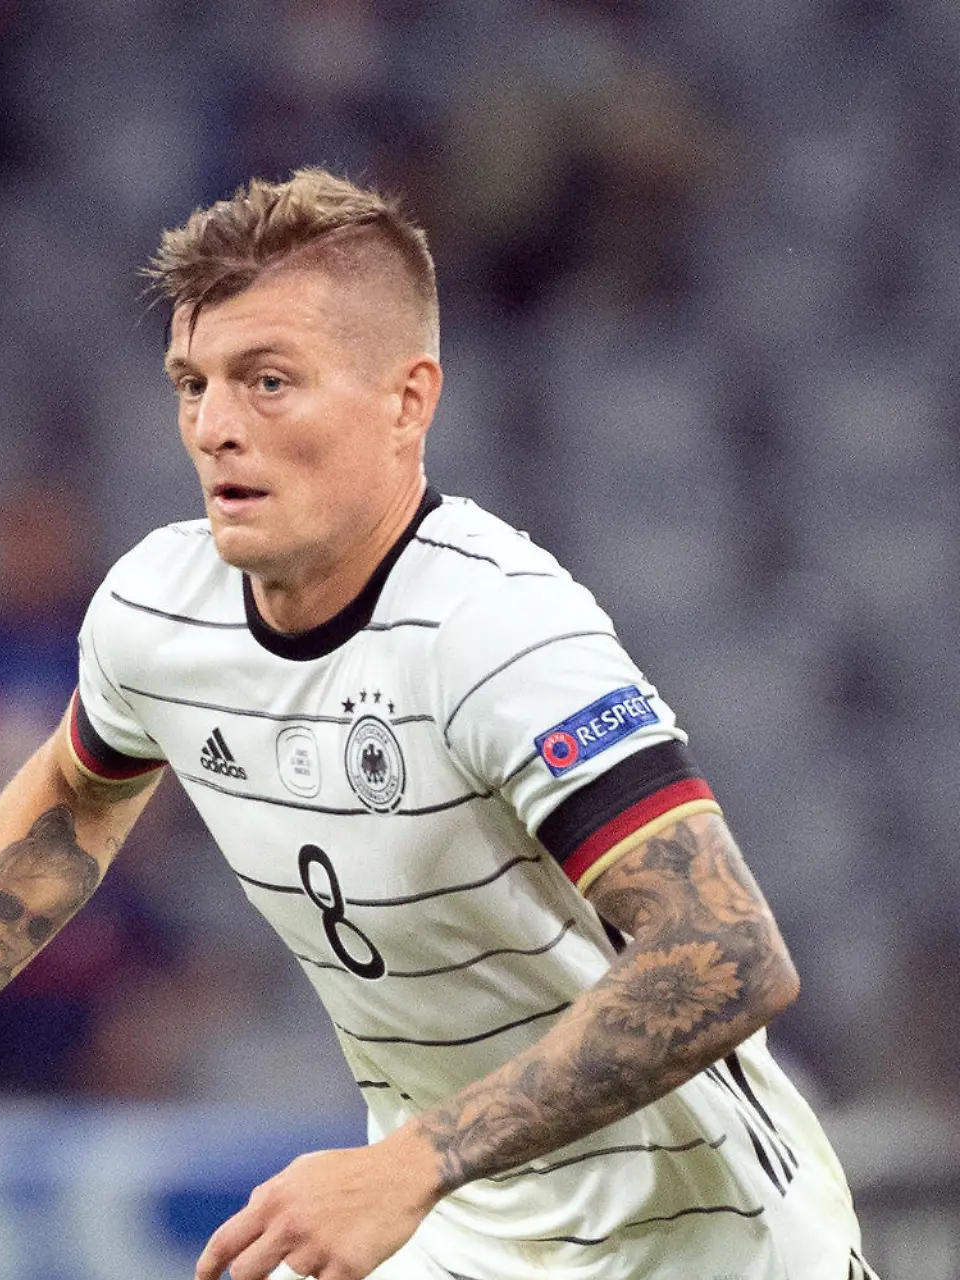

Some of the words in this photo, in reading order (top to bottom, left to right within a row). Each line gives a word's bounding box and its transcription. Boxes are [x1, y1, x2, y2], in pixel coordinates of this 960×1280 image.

[576, 696, 652, 746] RESPECT
[200, 756, 248, 781] adidas
[298, 843, 386, 980] 8
